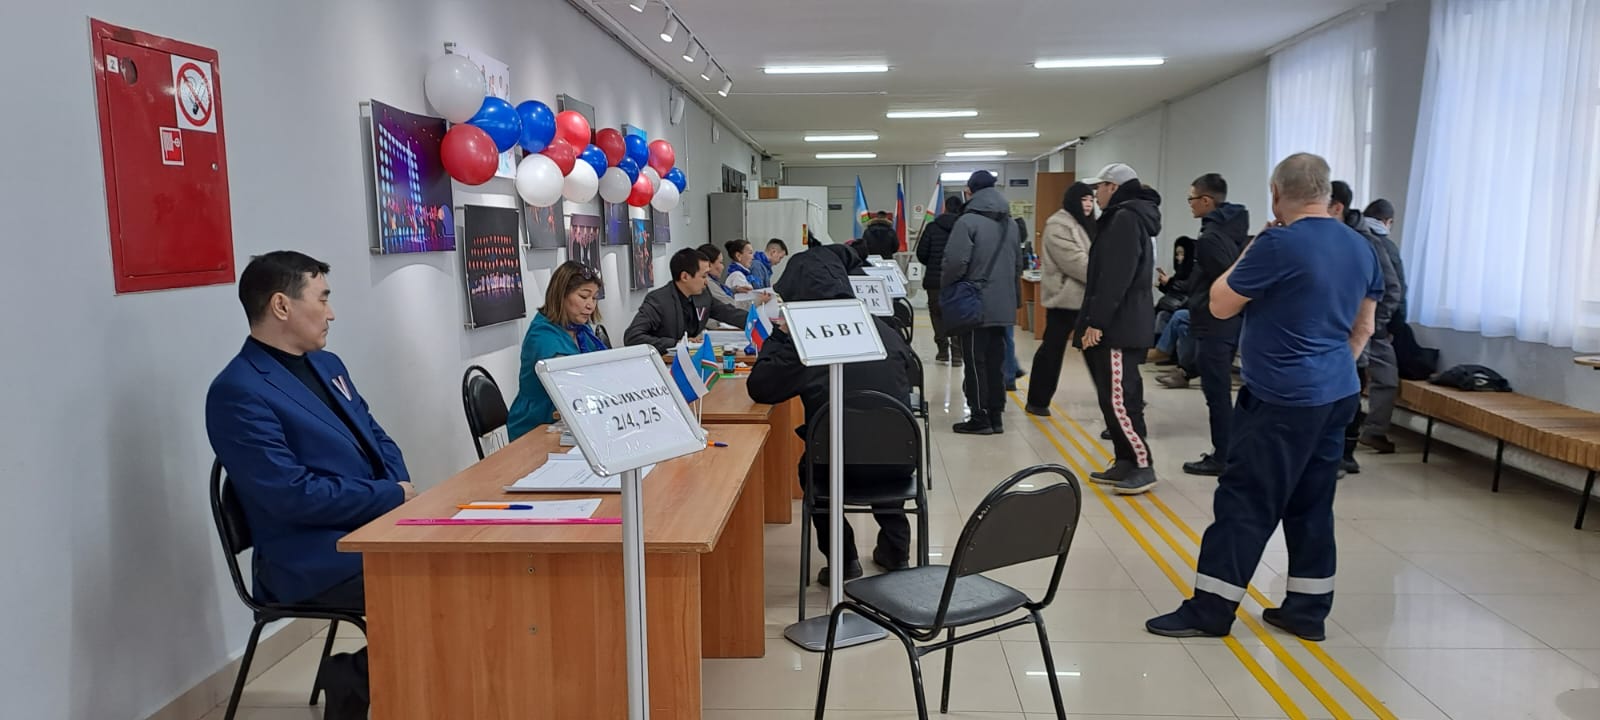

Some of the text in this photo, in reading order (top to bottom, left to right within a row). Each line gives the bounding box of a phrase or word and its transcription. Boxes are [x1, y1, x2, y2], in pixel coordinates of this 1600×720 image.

[110, 59, 116, 70] 2
[912, 266, 919, 276] 2
[572, 385, 670, 415] Сргеляхское
[612, 406, 662, 431] 2/4, 2/5
